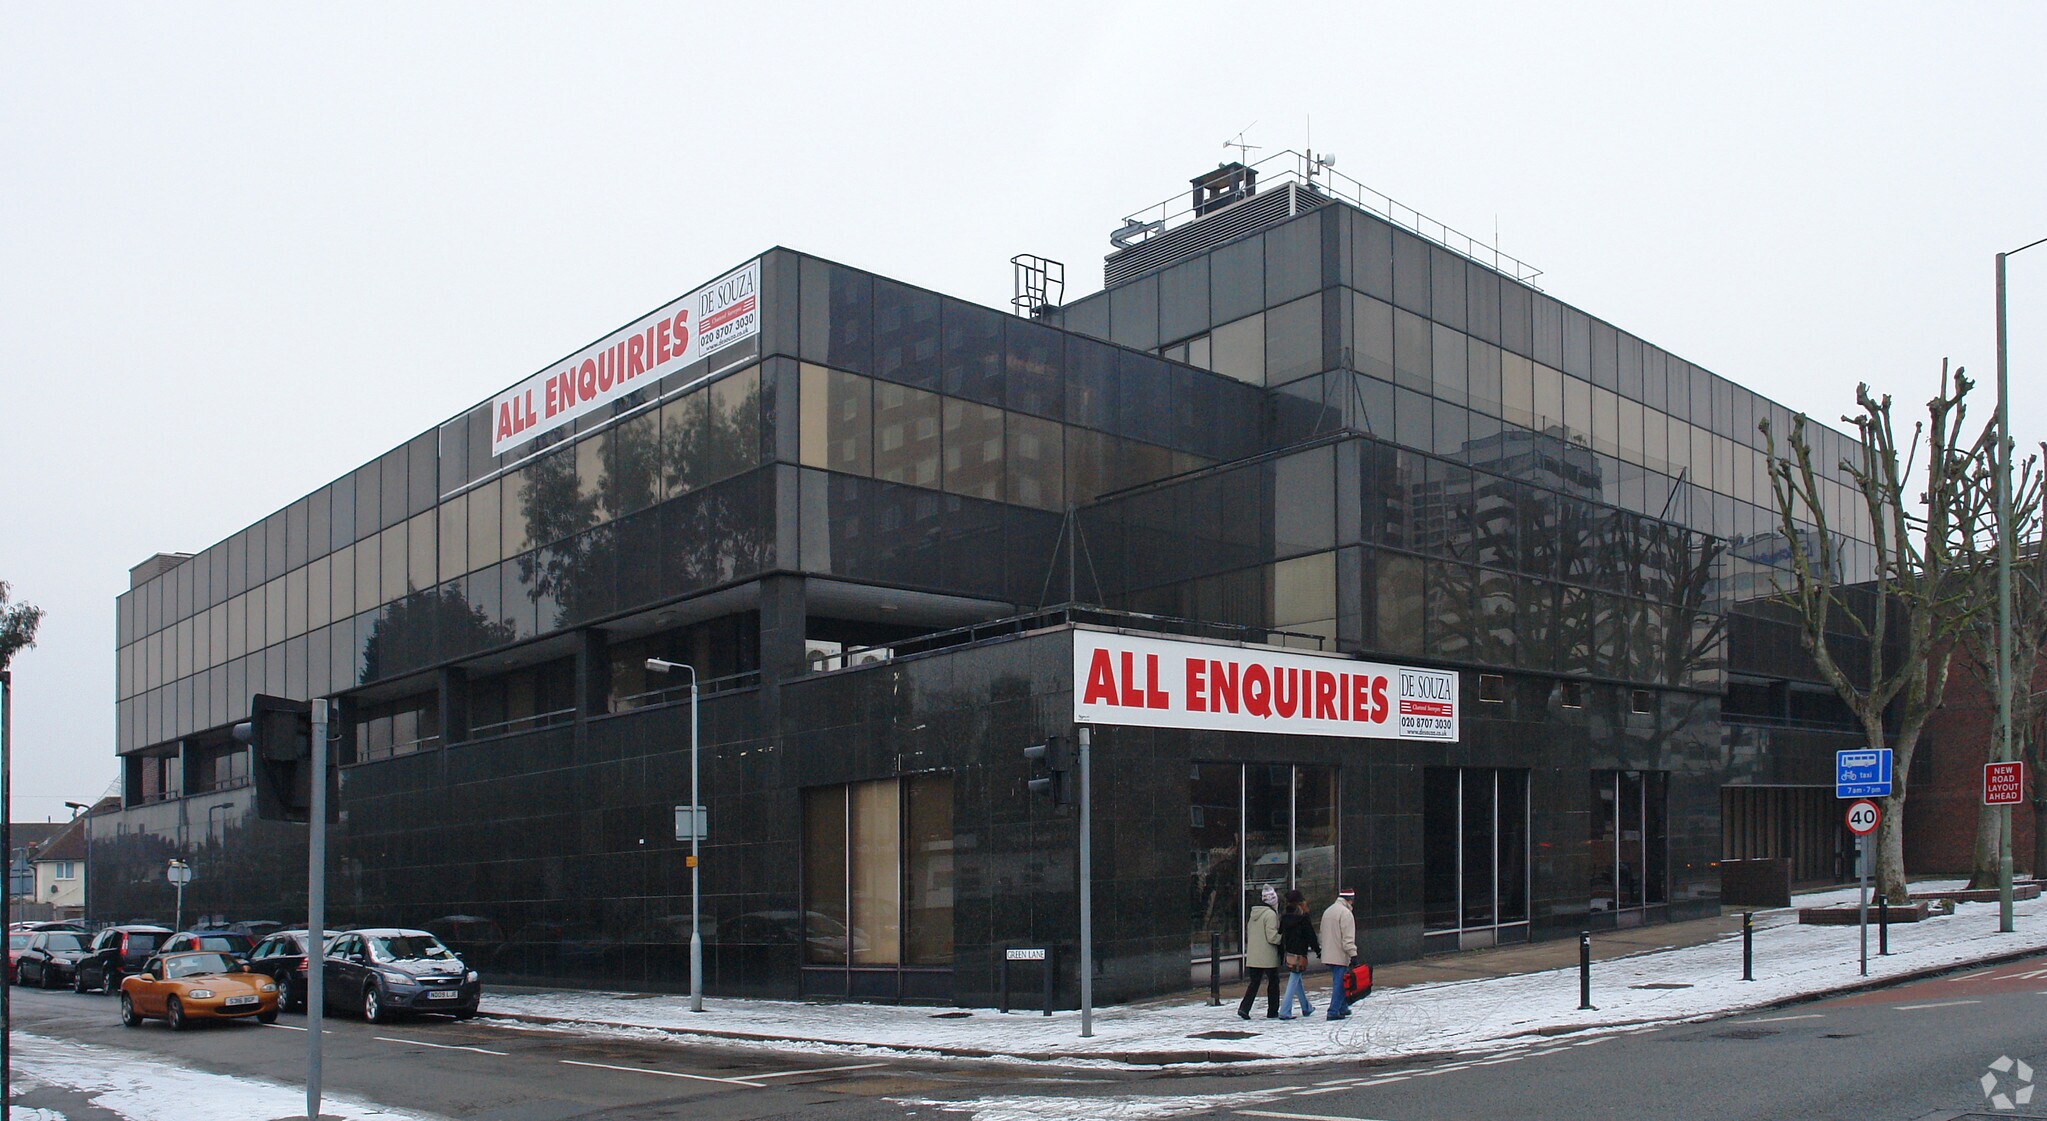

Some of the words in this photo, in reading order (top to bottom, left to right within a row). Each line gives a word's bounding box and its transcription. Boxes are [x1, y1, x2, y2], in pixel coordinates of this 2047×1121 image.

[701, 290, 714, 318] DE
[718, 270, 754, 309] SOUZA
[700, 332, 714, 347] 020
[715, 322, 734, 340] 8707
[735, 313, 754, 330] 3030
[496, 388, 537, 444] ALL
[545, 309, 689, 420] ENQUIRIES
[1083, 647, 1169, 710] ALL
[1185, 657, 1389, 724] ENQUIRIES
[1401, 674, 1415, 697] DE
[1418, 675, 1451, 700] SOUZA
[1401, 716, 1415, 728] 020
[1416, 717, 1433, 729] 8707
[1435, 719, 1452, 730] 3030
[1988, 782, 2019, 792] LAYOUT
[1992, 775, 2014, 783] ROAD
[1989, 792, 2017, 800] AHEAD
[1851, 810, 1875, 824] 40
